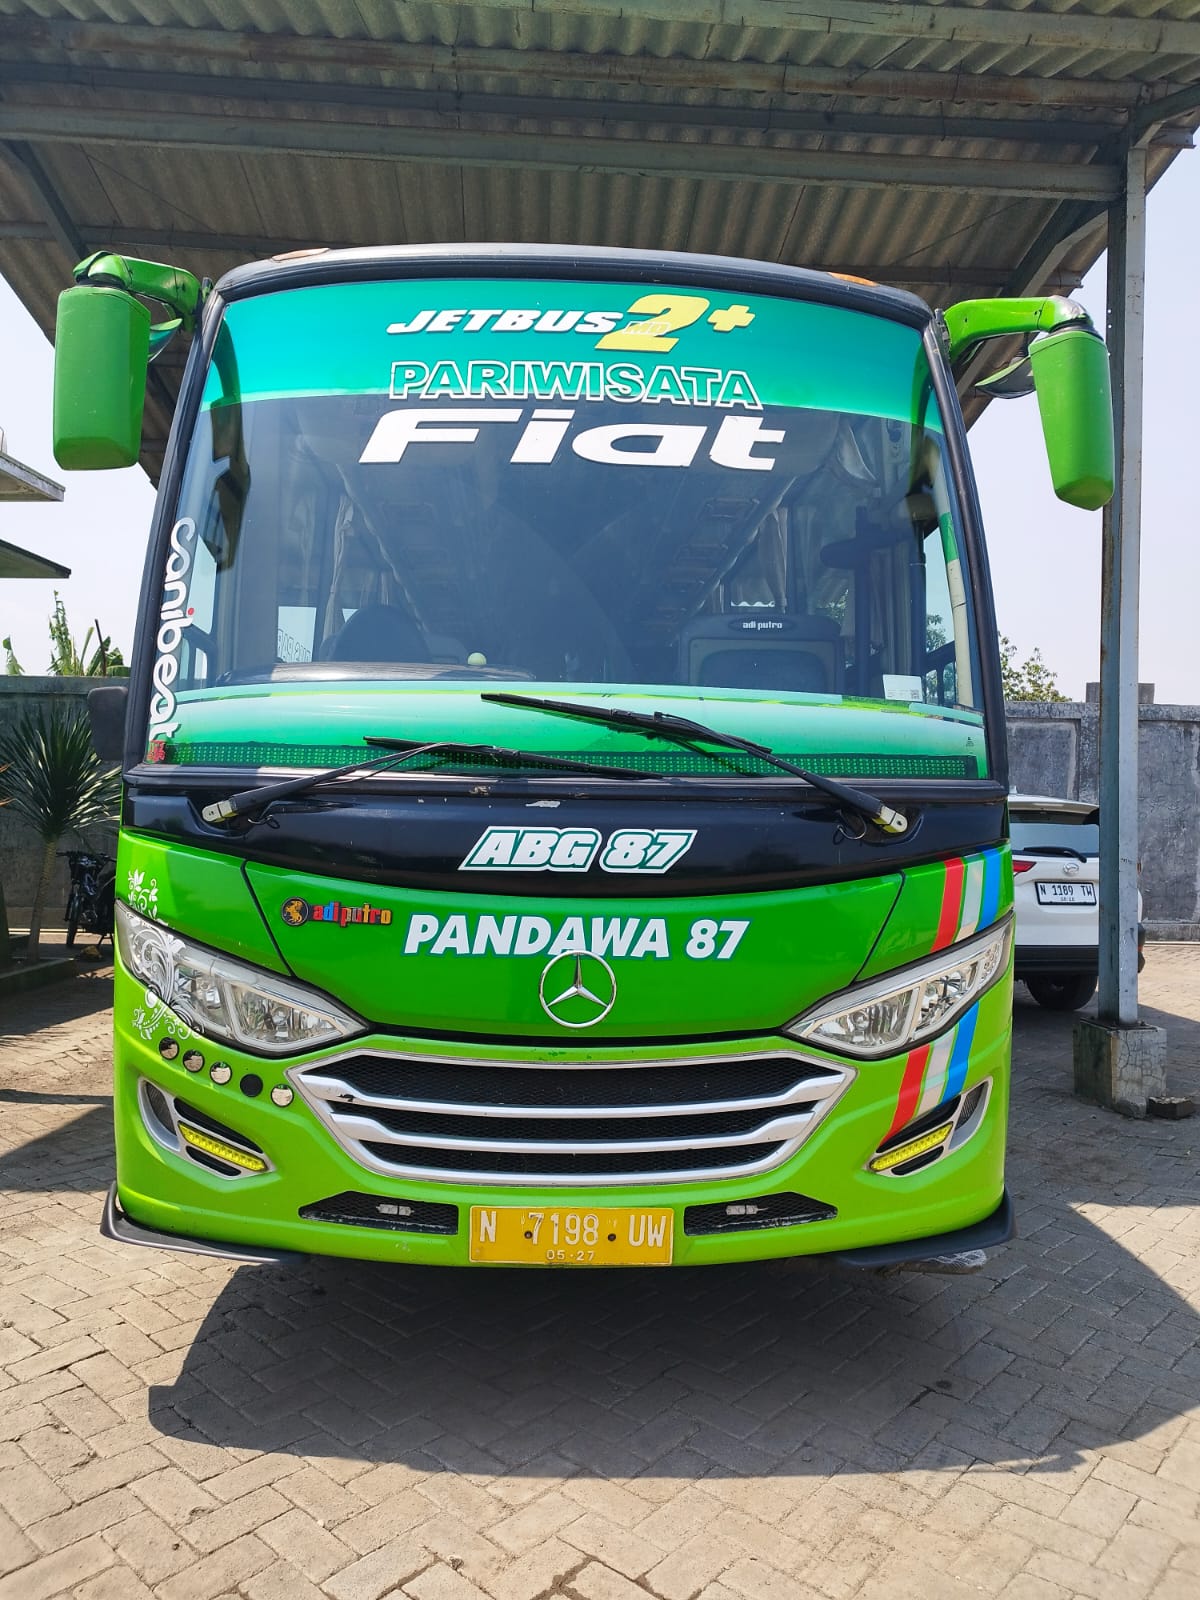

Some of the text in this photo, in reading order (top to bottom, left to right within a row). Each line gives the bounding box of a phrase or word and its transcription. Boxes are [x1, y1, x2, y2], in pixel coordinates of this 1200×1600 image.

[386, 310, 623, 335] JETBUS
[389, 360, 764, 411] PARIWISATA
[358, 409, 786, 471] Fiat
[458, 826, 698, 873] ABG 87
[1039, 884, 1047, 896] N
[1052, 884, 1074, 896] 1189
[404, 914, 750, 959] PANDAWA 87
[479, 1210, 667, 1247] N 7198 UW
